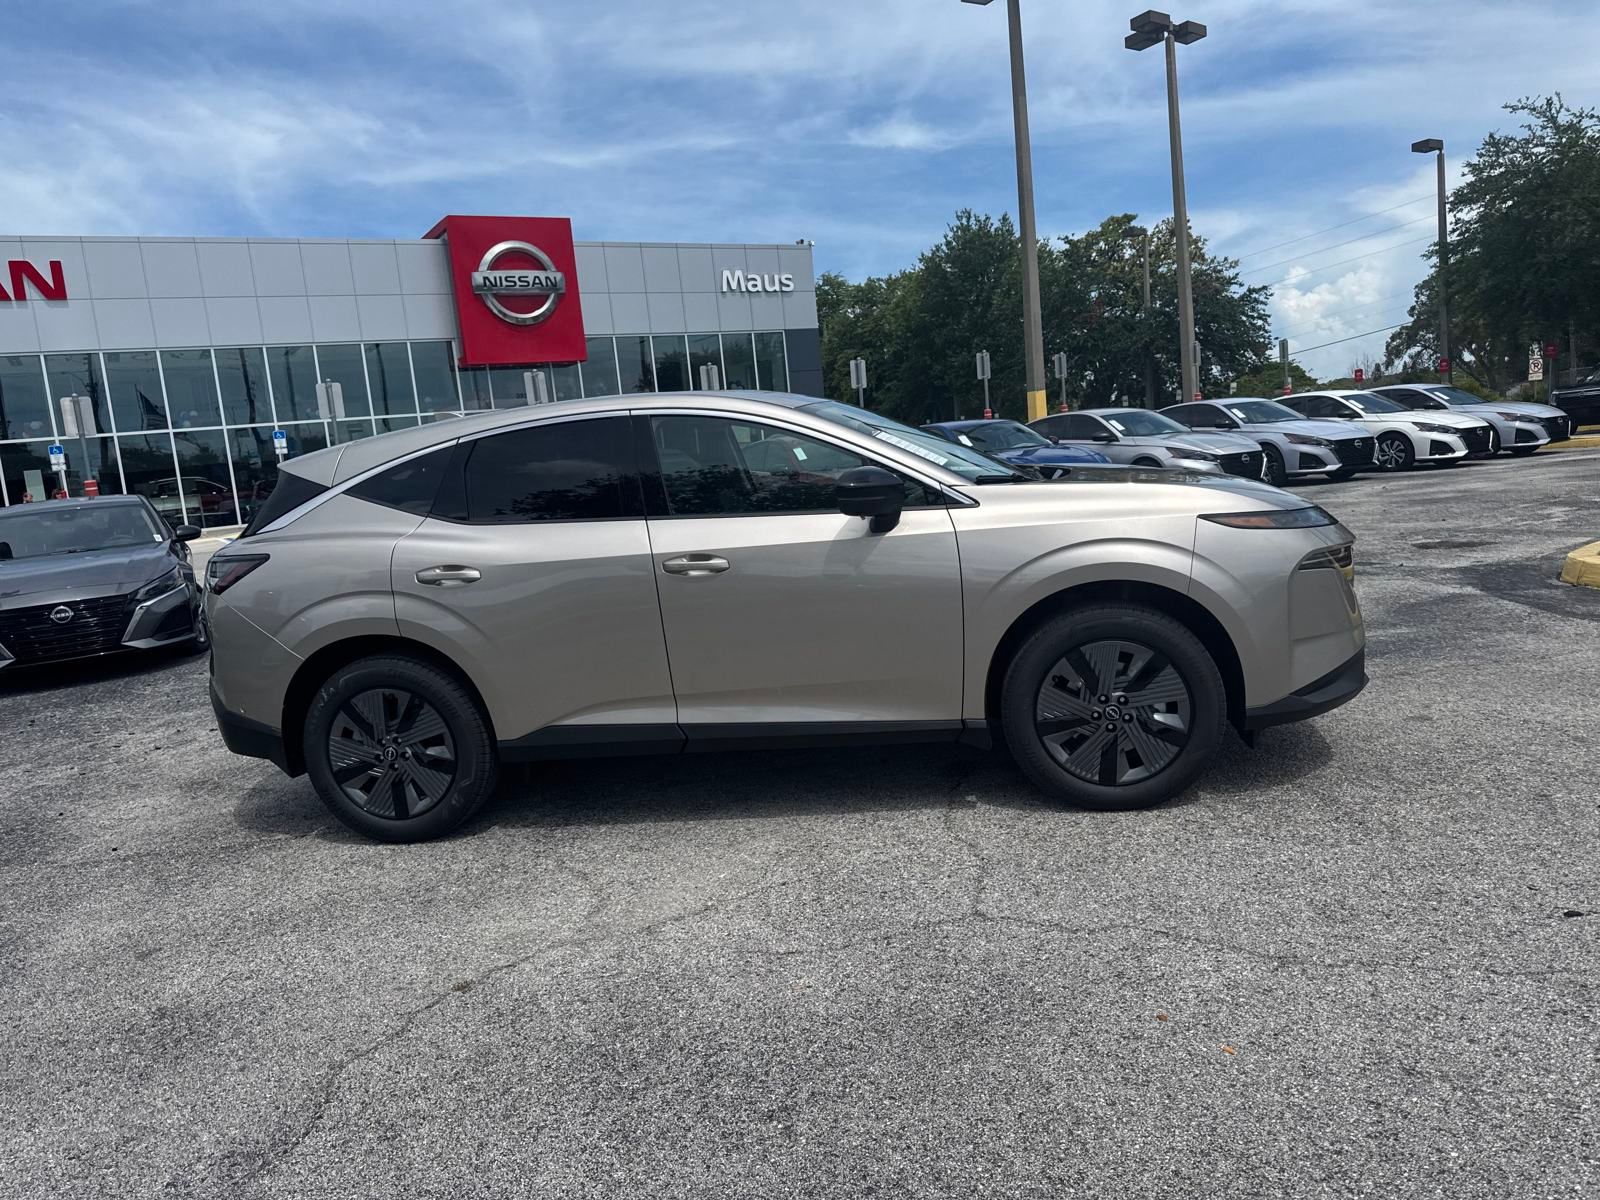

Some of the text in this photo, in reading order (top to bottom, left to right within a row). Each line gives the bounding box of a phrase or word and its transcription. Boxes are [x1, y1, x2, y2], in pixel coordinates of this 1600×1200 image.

[0, 260, 68, 301] N
[482, 275, 558, 288] NISSAN
[722, 269, 795, 292] Maus
